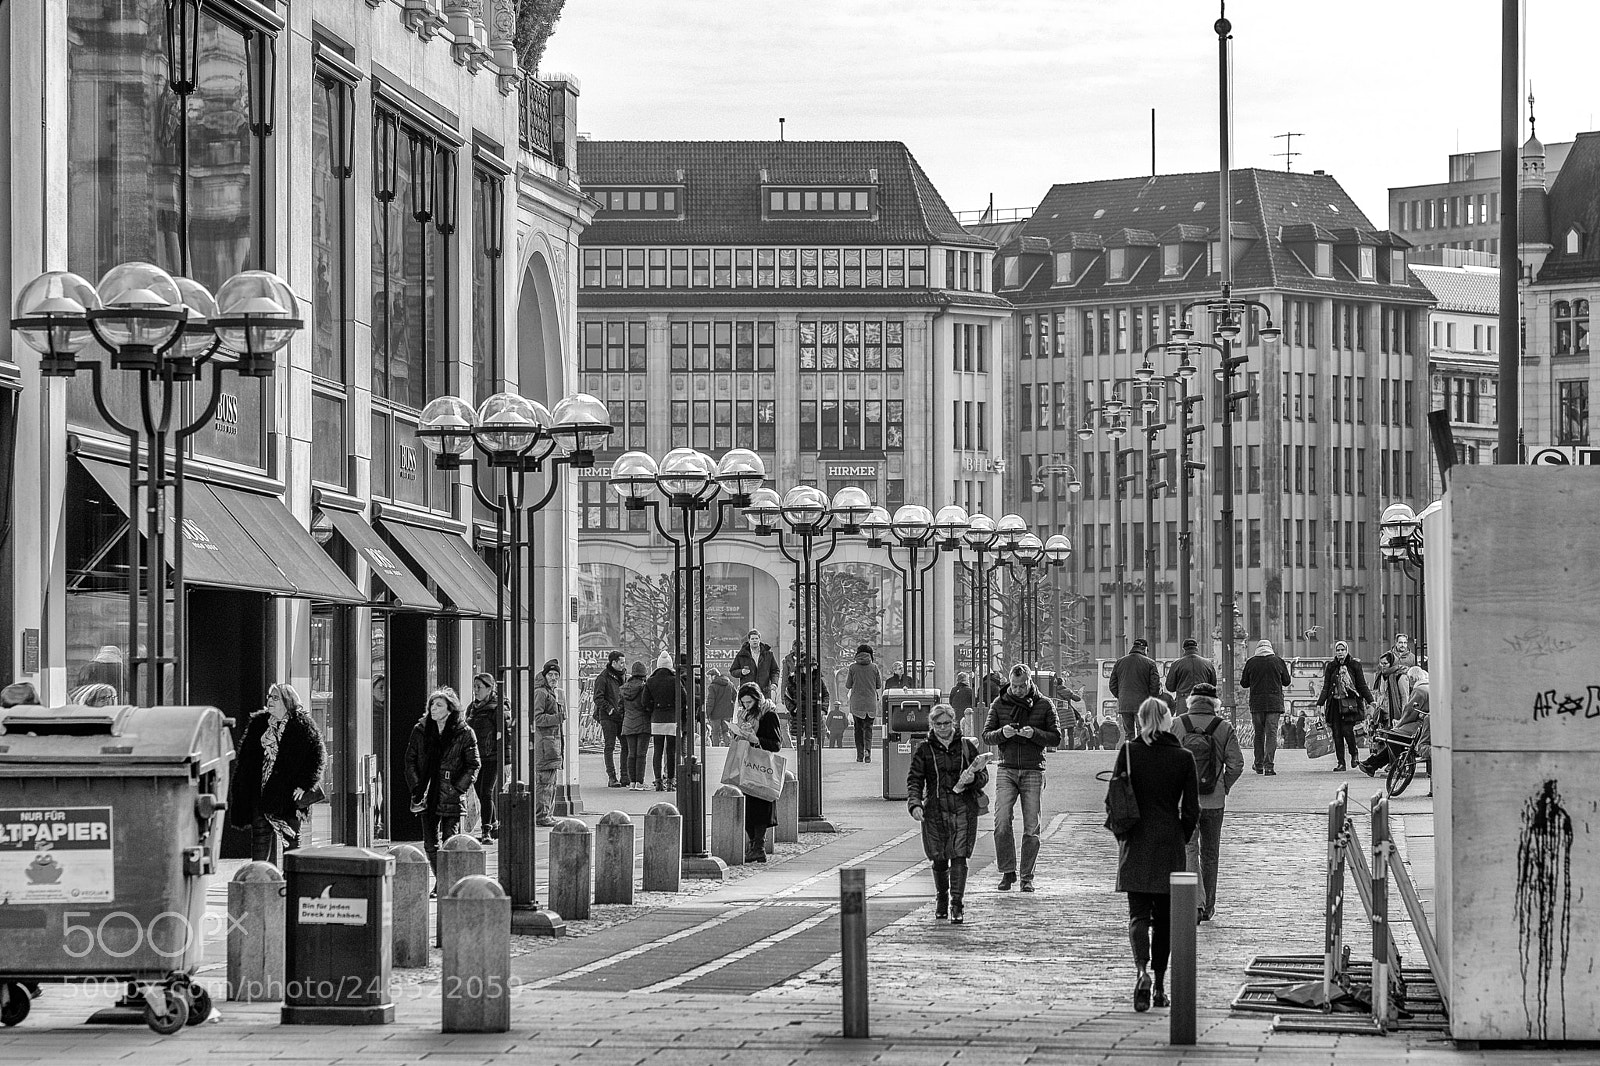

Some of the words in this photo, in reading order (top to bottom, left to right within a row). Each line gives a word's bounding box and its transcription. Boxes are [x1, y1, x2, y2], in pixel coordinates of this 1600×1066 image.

[400, 445, 416, 471] BOSS
[829, 466, 876, 476] HIRMER
[20, 811, 43, 821] NUR
[44, 810, 66, 821] FÜR
[316, 903, 327, 911] für
[328, 903, 350, 911] jeden
